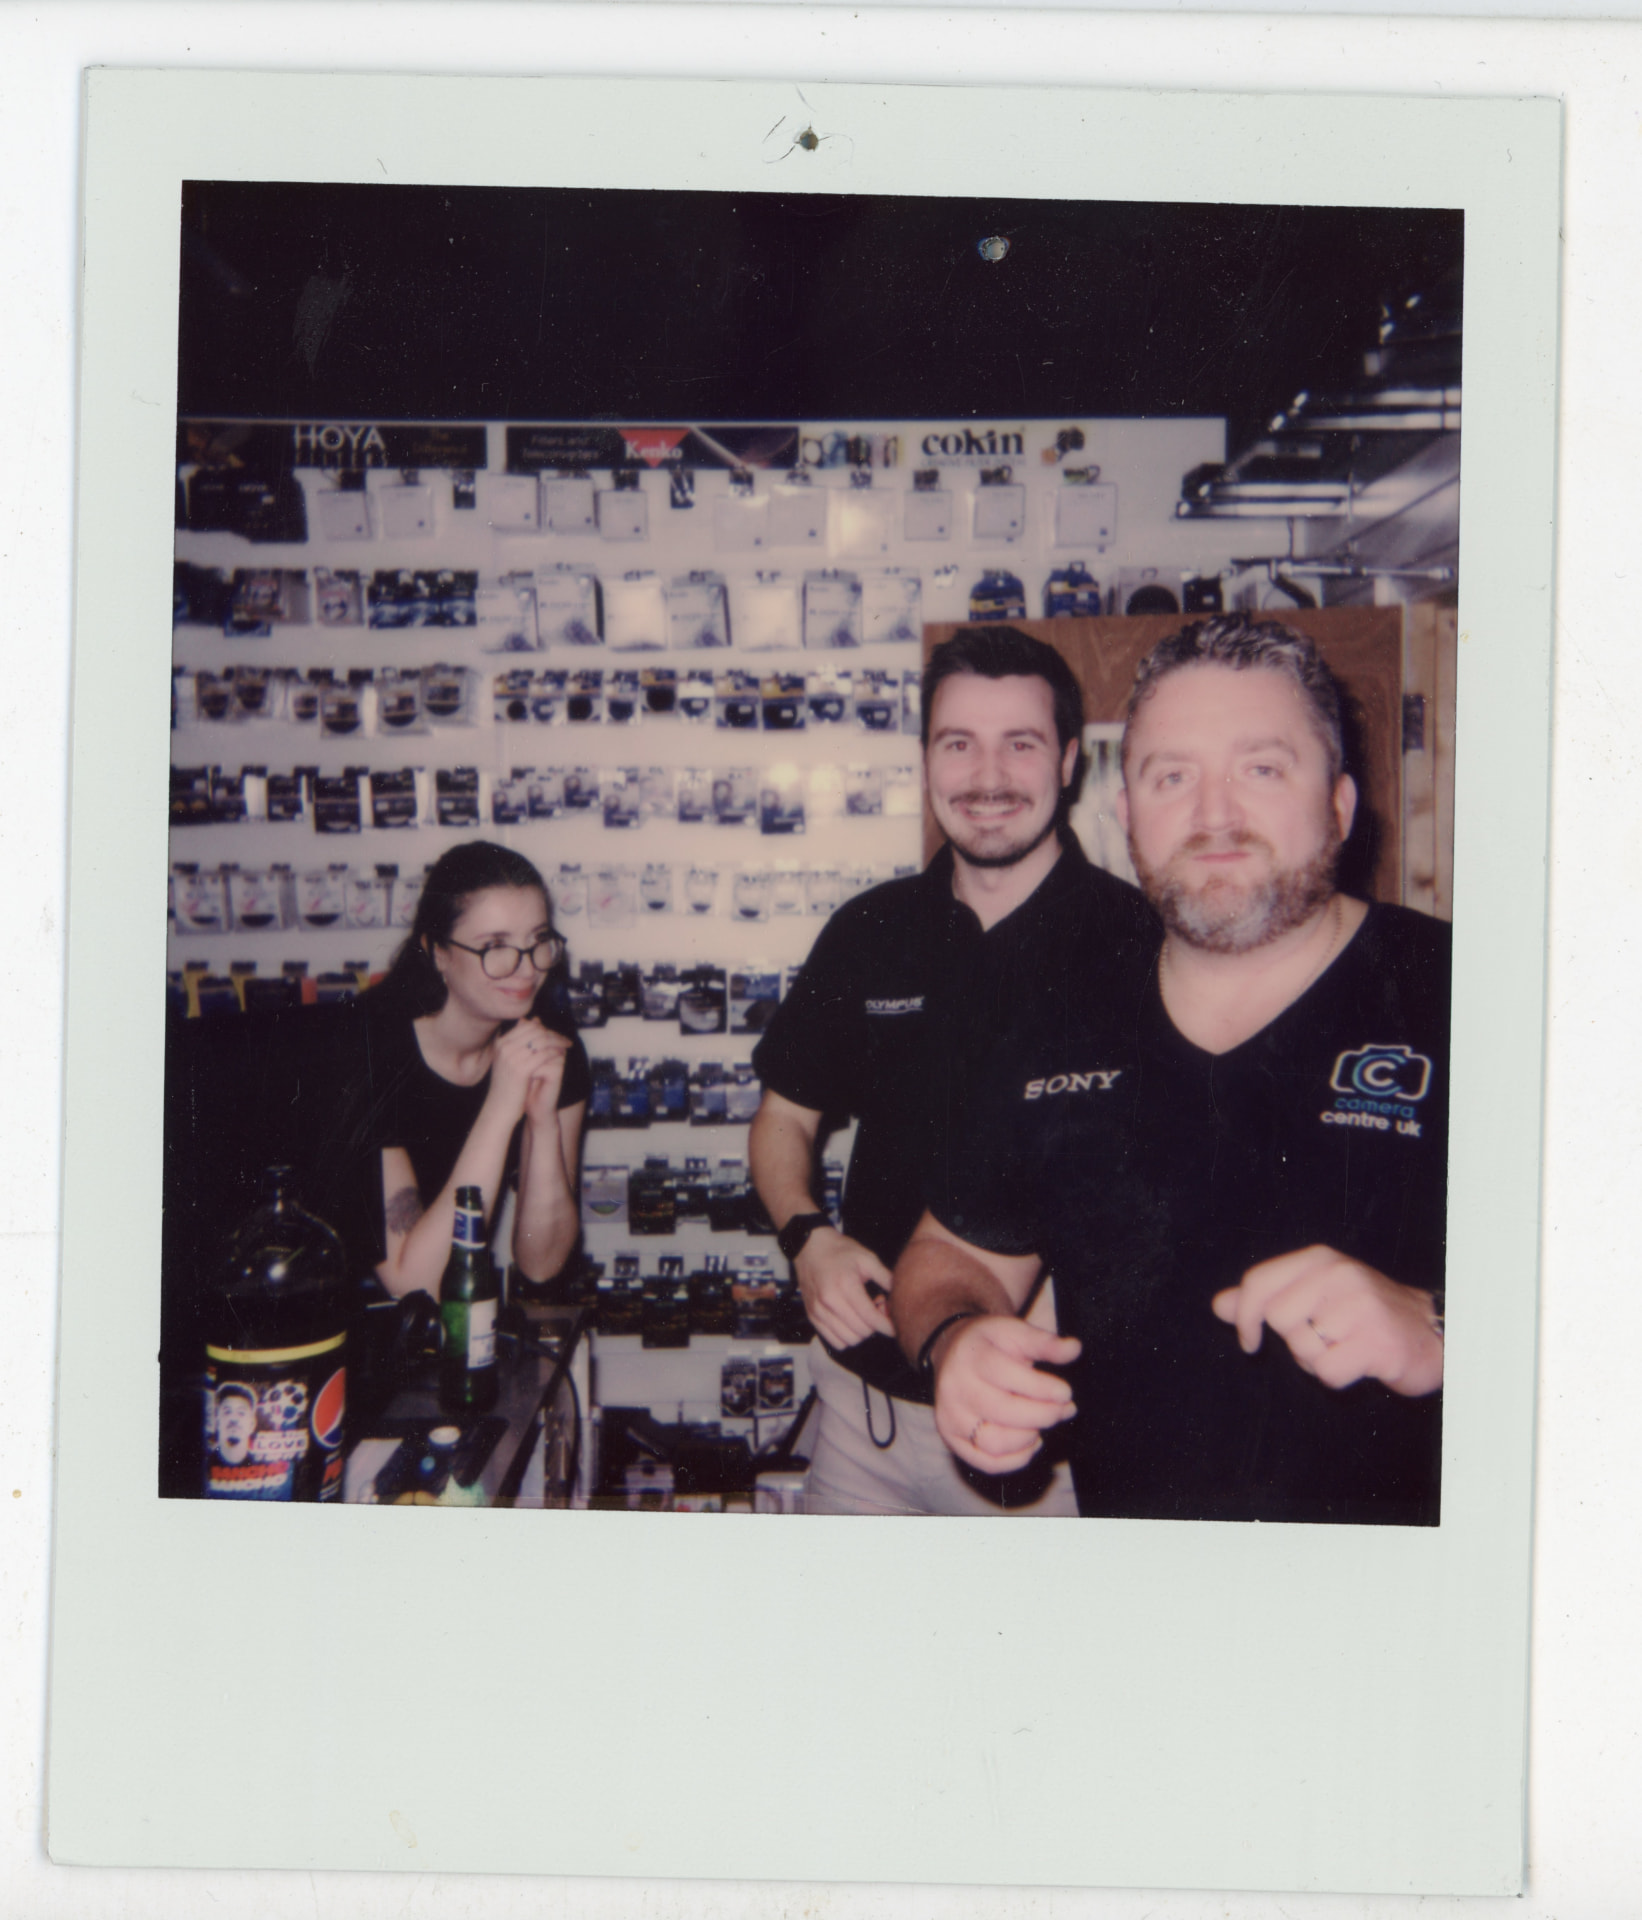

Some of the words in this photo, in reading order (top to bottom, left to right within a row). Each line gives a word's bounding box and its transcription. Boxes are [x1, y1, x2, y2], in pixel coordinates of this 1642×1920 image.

[294, 425, 386, 449] HOYA
[921, 428, 1024, 456] cokin
[625, 439, 683, 459] Kenko
[865, 996, 925, 1010] OLYMPUS
[1024, 1070, 1122, 1100] SONY
[1334, 1097, 1415, 1118] camera
[1320, 1111, 1391, 1131] centre
[1395, 1120, 1422, 1137] uk
[257, 1438, 306, 1450] LOVE
